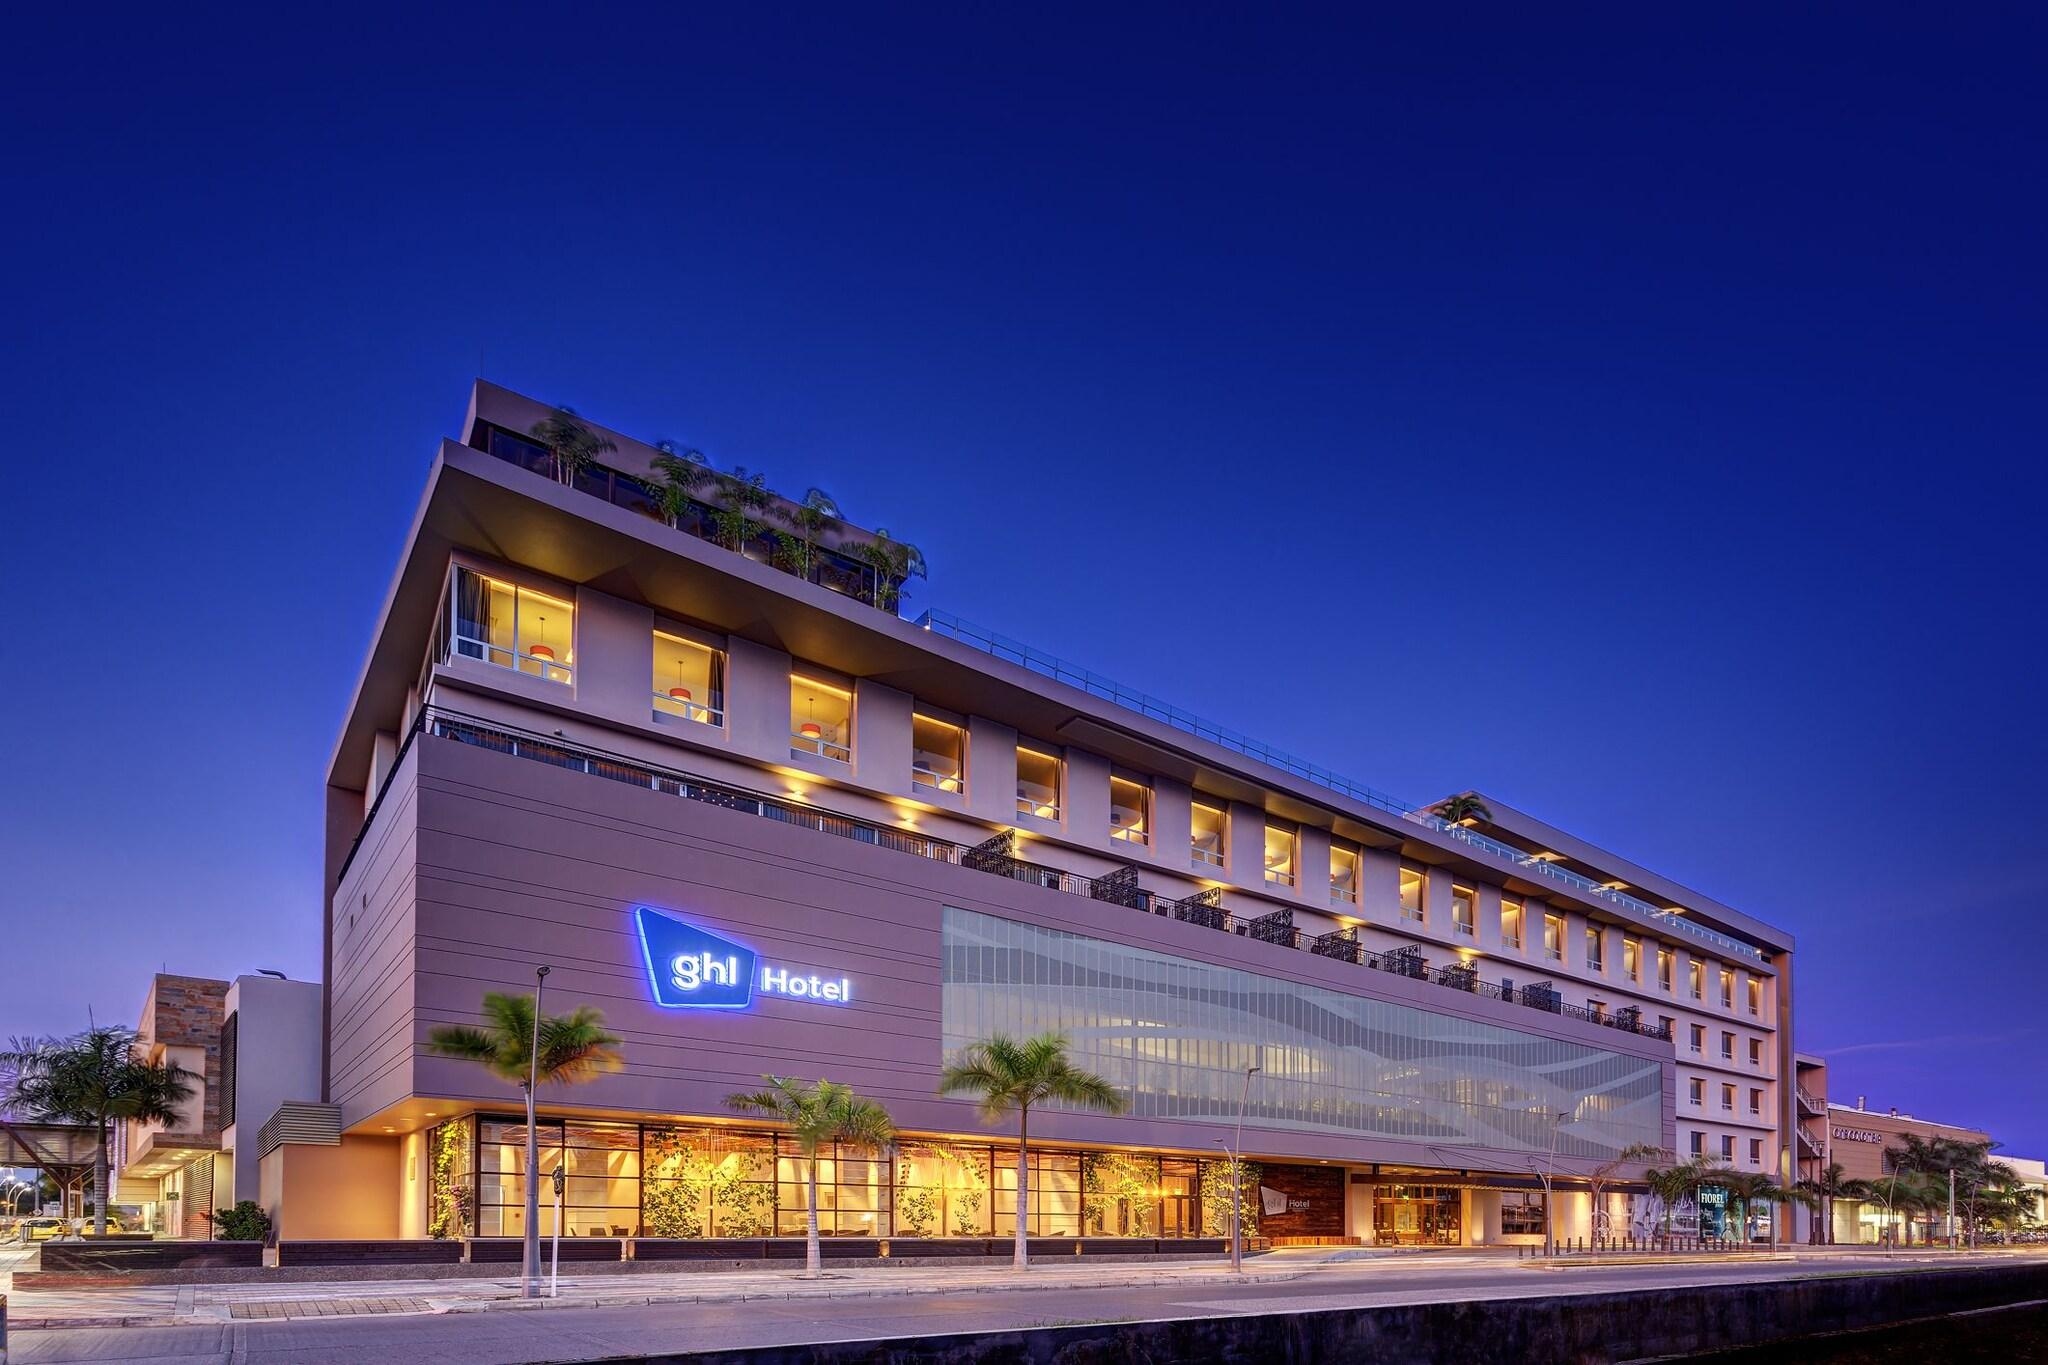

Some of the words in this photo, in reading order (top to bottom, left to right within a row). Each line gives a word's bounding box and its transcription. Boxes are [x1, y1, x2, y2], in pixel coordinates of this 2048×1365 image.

[672, 952, 737, 990] ghl
[763, 967, 849, 1002] Hotel
[1267, 1198, 1282, 1210] ghl
[1288, 1199, 1310, 1208] Hotel
